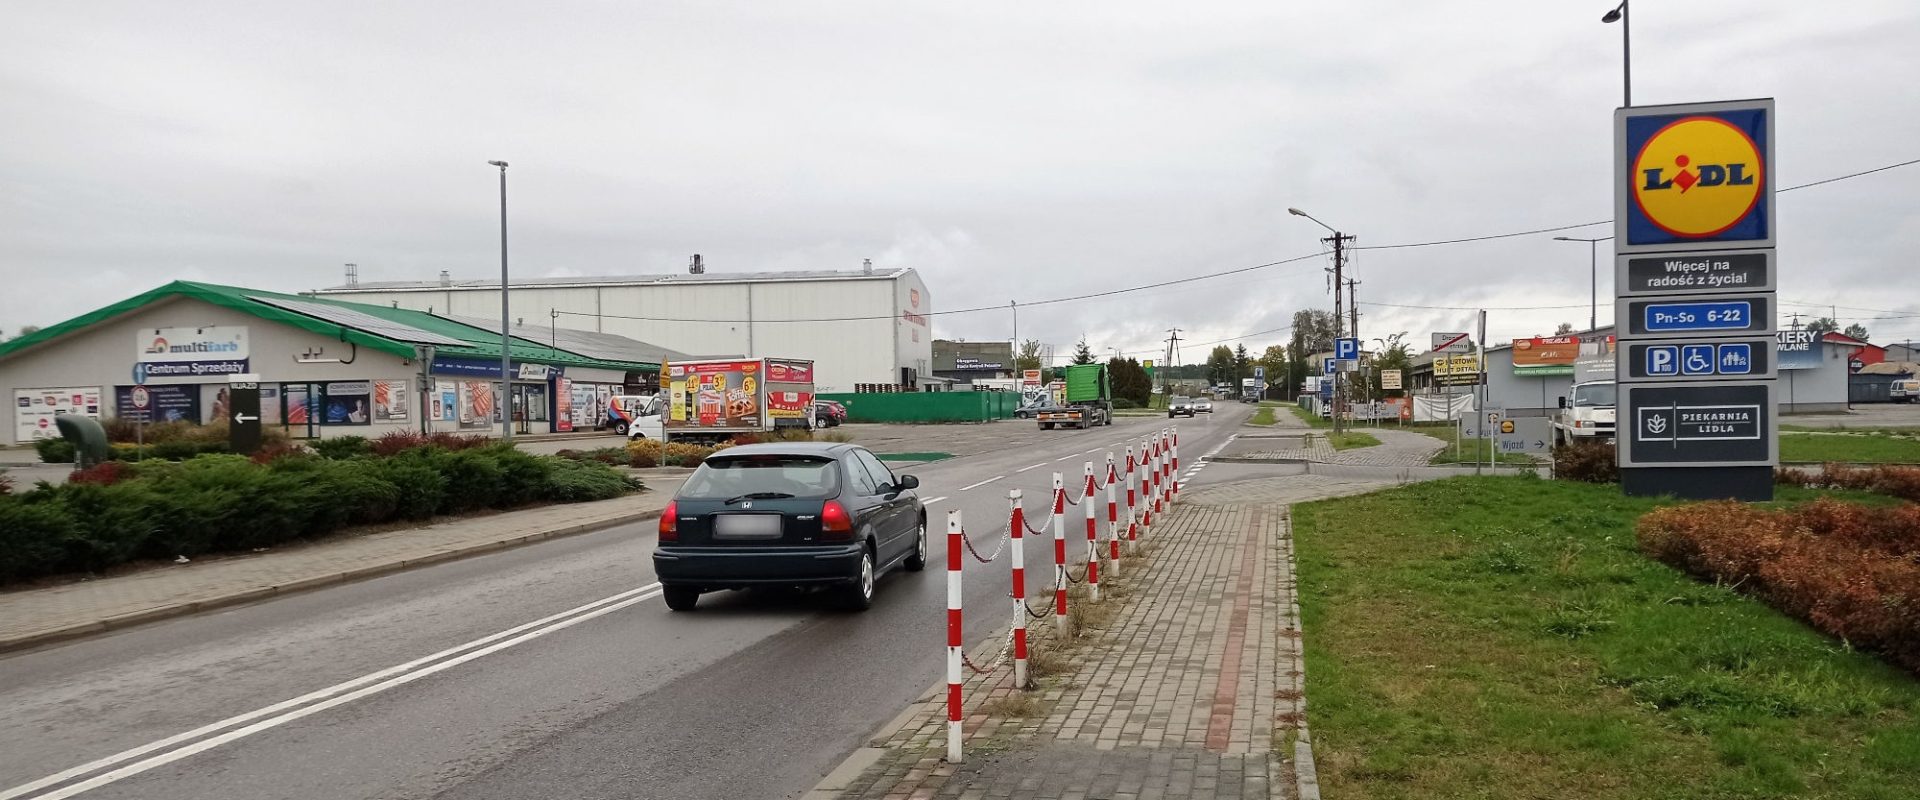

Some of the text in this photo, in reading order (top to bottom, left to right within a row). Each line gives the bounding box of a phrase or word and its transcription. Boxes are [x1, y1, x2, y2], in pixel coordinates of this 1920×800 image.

[1665, 260, 1730, 273] Więcej na
[1648, 273, 1747, 287] radość z życia!
[1655, 309, 1741, 324] Pn-So 6-22
[170, 341, 238, 353] multifarb
[1340, 340, 1354, 358] P
[145, 361, 244, 375] Centrum Sprzedaży
[1436, 366, 1454, 374] HUT
[1682, 412, 1749, 421] PIEKARNIA
[1699, 425, 1735, 433] LIDLA
